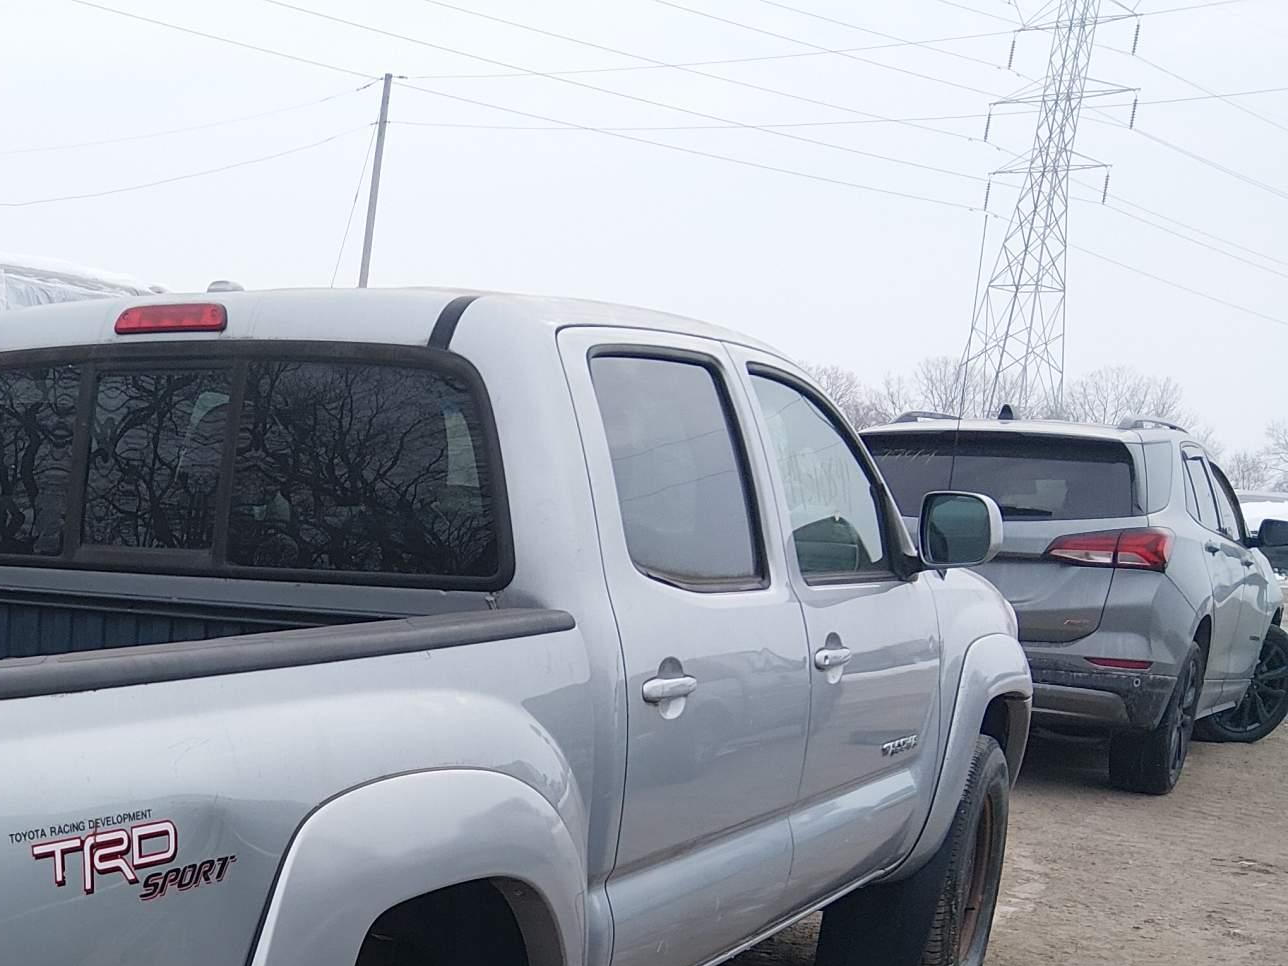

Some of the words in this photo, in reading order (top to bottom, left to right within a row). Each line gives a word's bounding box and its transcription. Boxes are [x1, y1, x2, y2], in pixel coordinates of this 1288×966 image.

[8, 828, 47, 844] TOYOTA
[49, 820, 86, 837] RACING
[88, 809, 153, 830] DEVELOPMENT
[30, 819, 179, 896] TRD
[139, 855, 238, 901] SPORT
